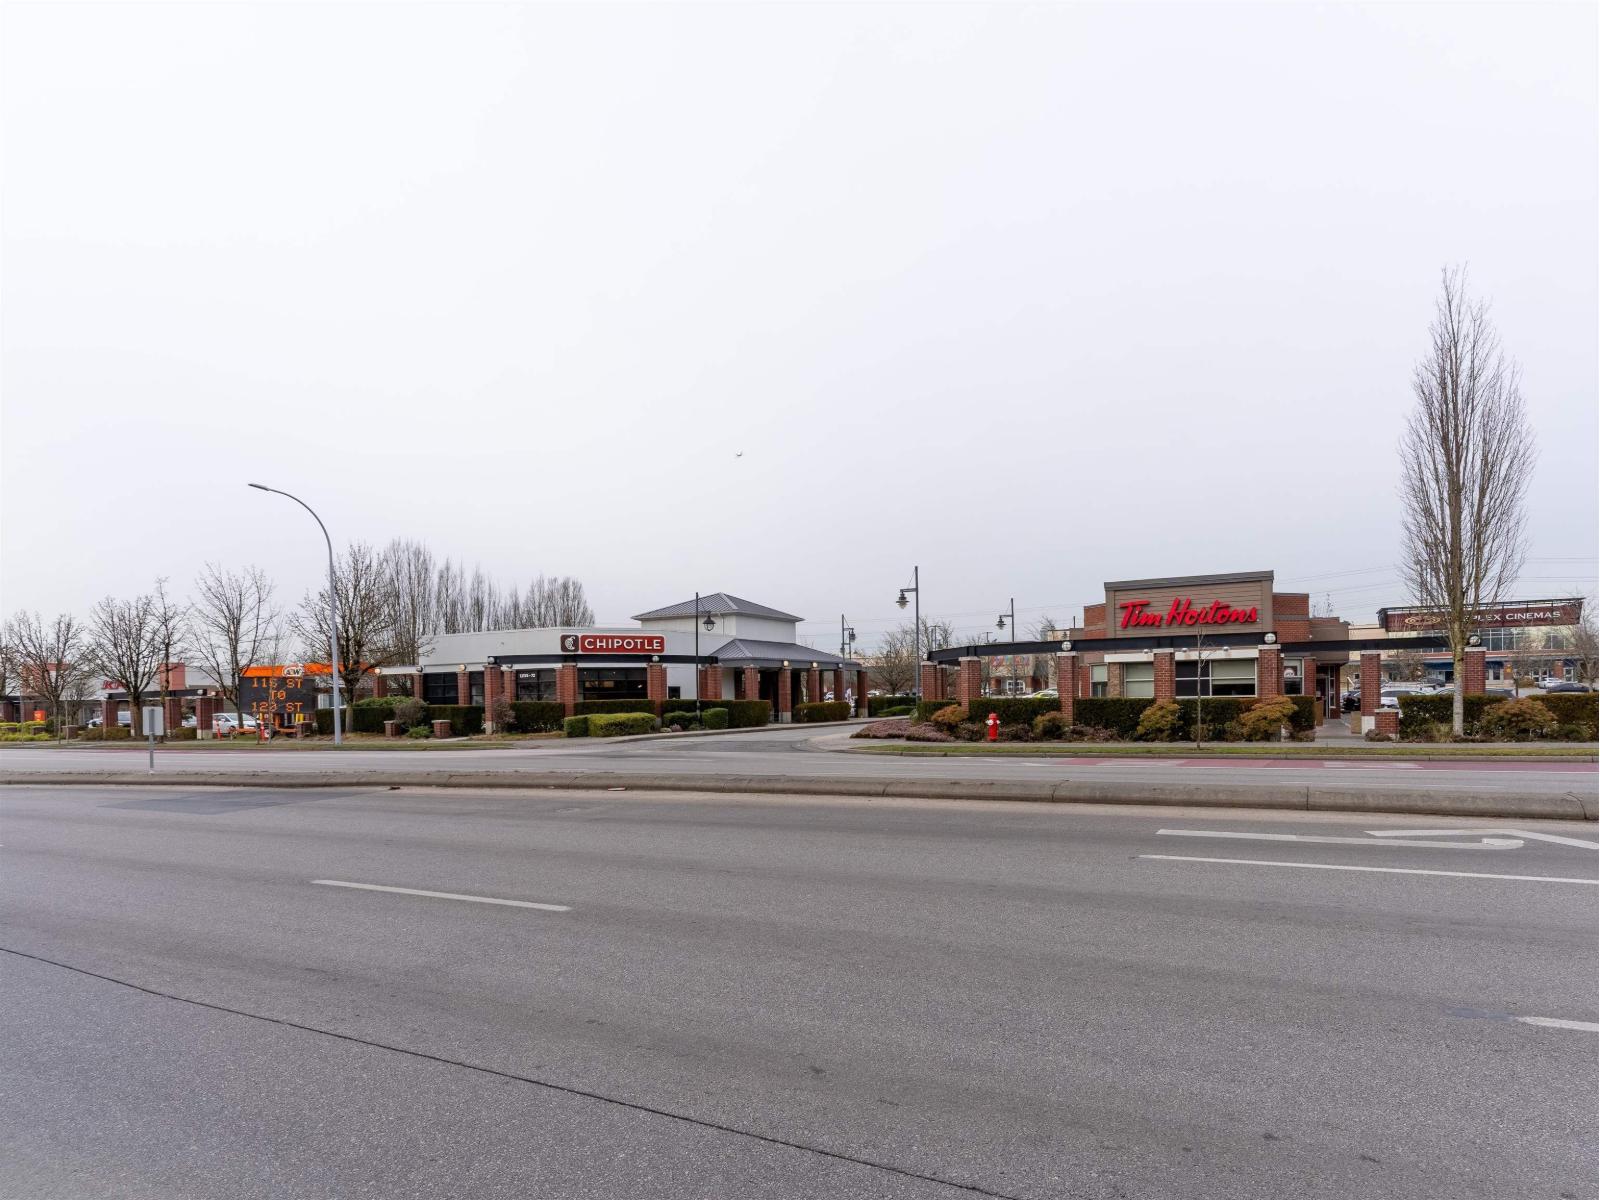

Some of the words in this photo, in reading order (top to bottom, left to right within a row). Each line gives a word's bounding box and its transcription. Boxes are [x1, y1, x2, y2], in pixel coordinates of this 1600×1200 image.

[1119, 600, 1163, 629] Tim
[1165, 596, 1258, 626] Hortons
[1505, 611, 1561, 620] CINEMAS
[584, 638, 662, 650] CHIPOTLE
[286, 678, 303, 688] ST
[271, 690, 286, 700] TO
[286, 702, 303, 712] ST
